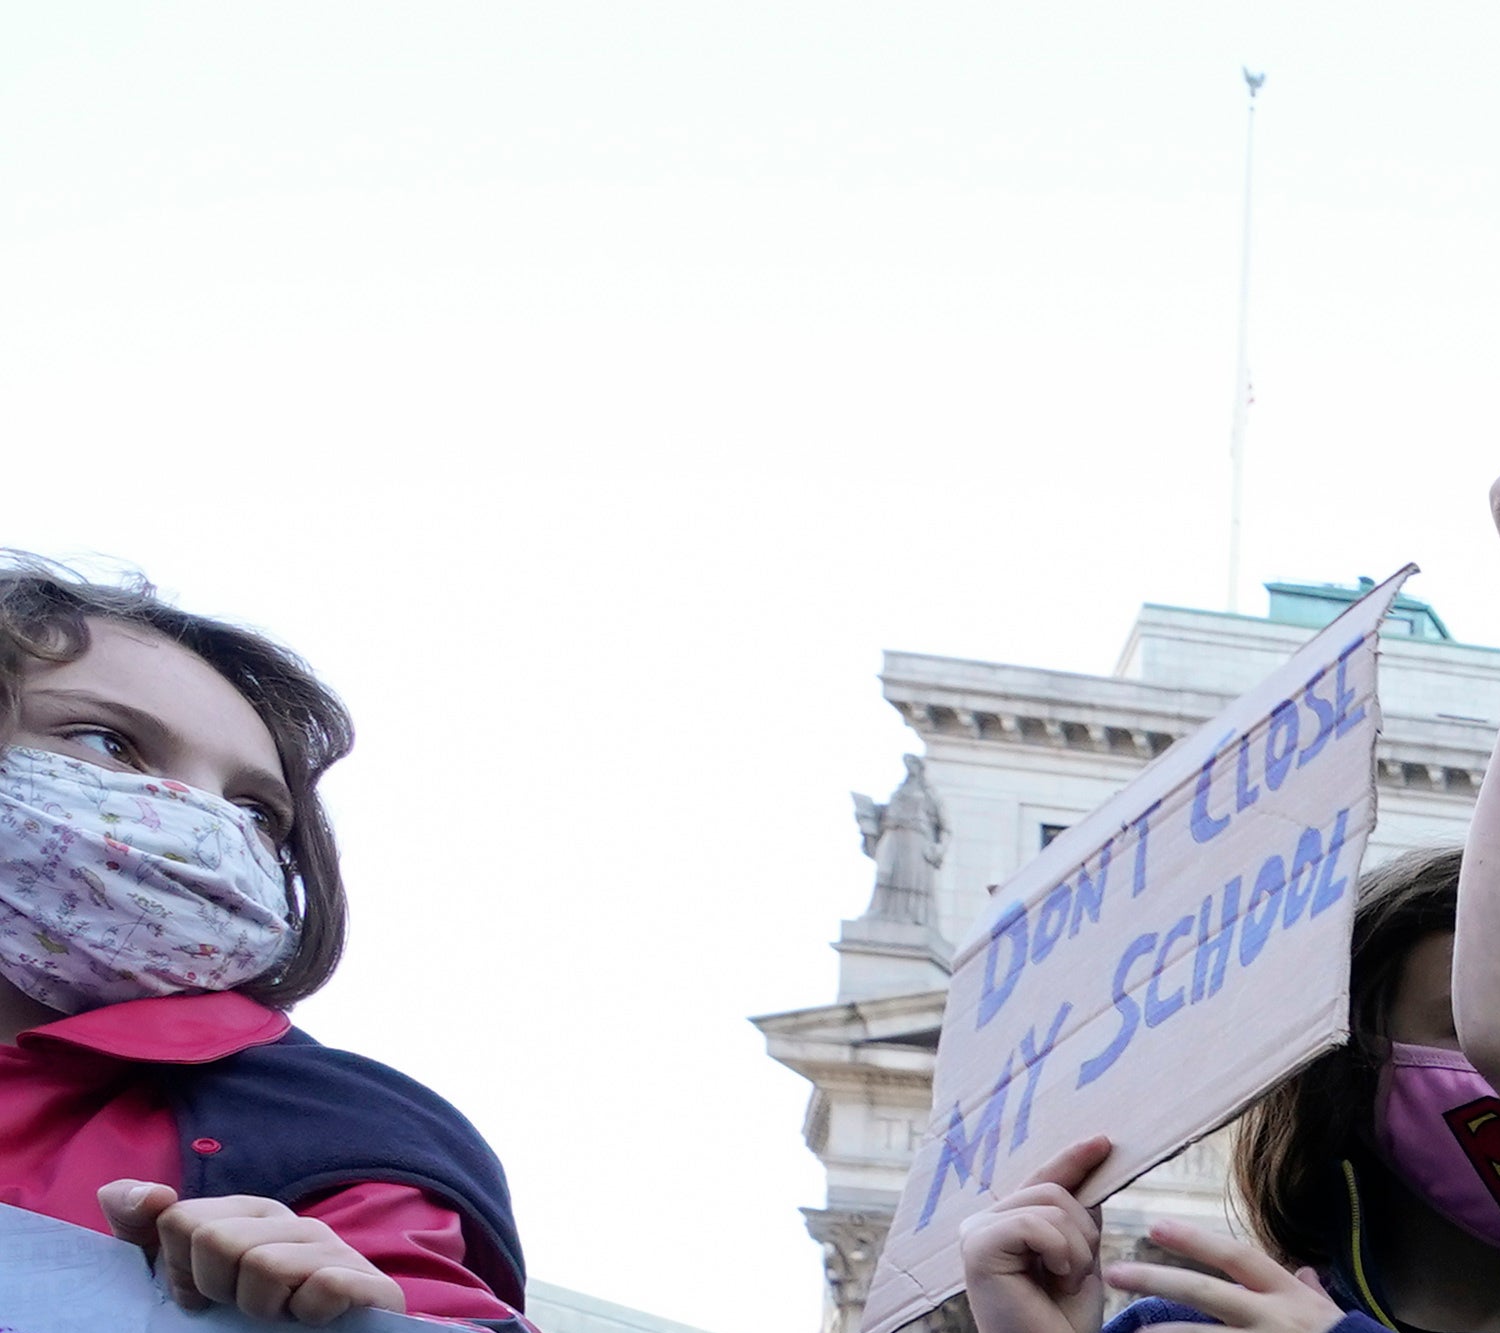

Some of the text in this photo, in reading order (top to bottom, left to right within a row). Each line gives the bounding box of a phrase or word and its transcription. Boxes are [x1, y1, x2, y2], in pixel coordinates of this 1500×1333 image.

[914, 809, 1349, 1234] MY SCHOOL
[976, 634, 1367, 1028] DON'T CLOSE
